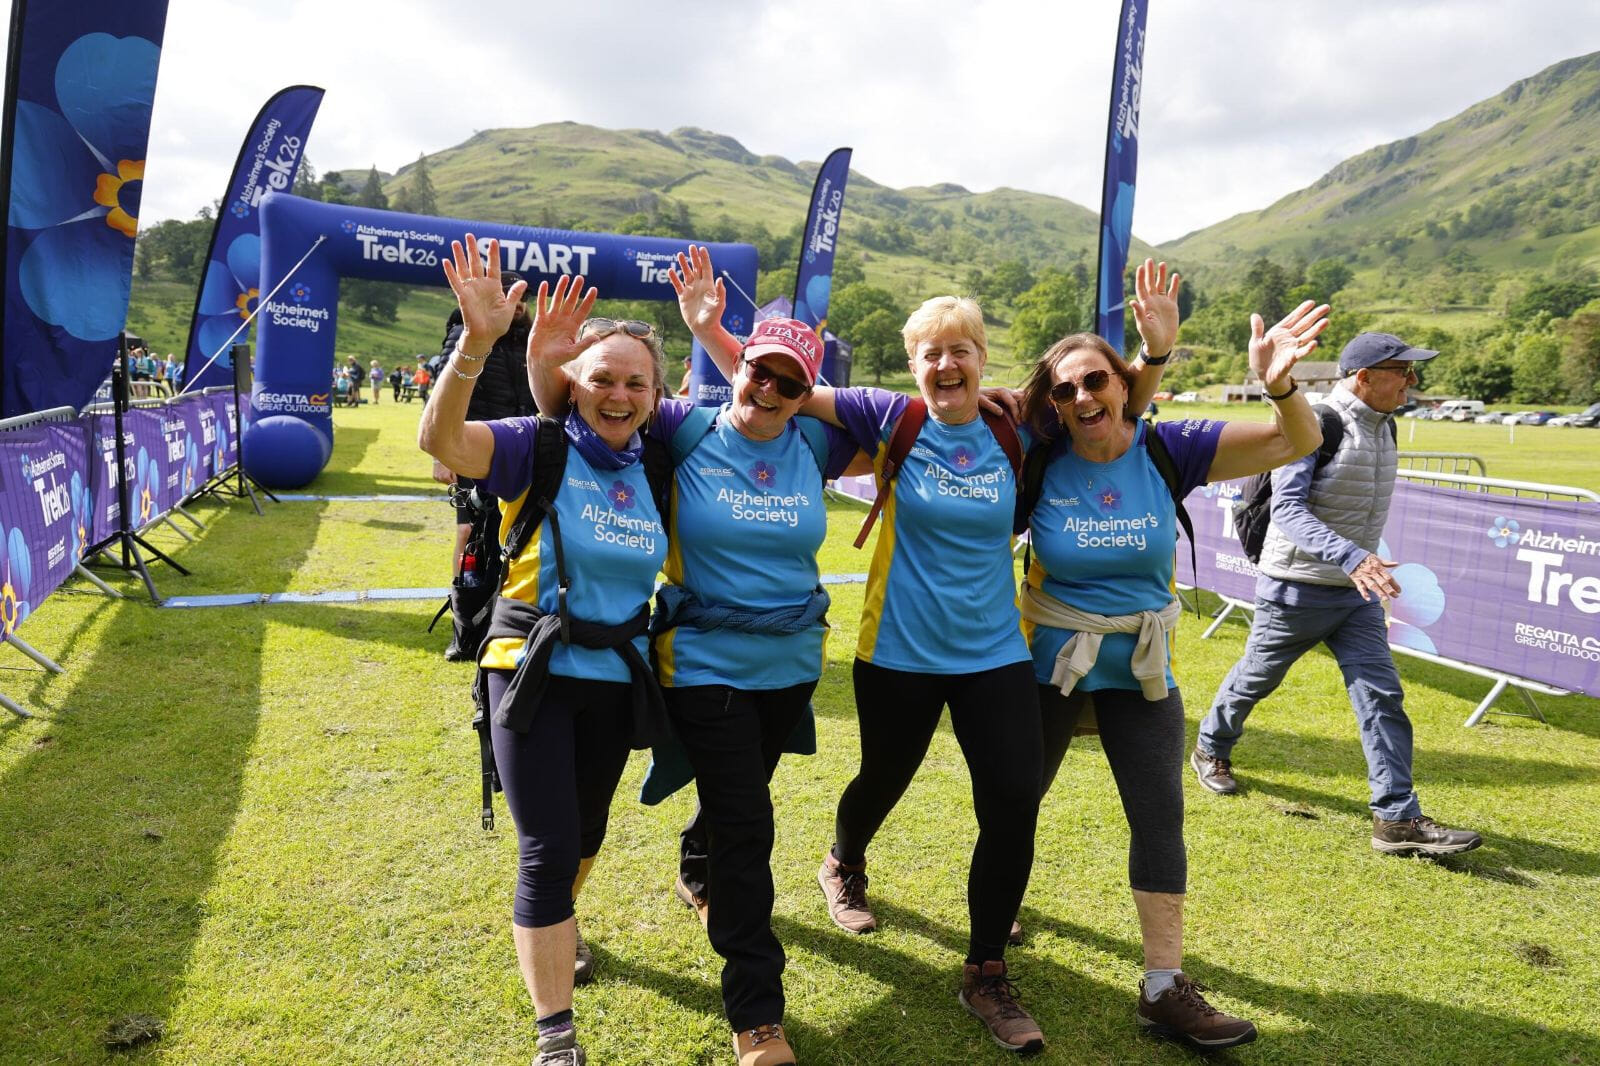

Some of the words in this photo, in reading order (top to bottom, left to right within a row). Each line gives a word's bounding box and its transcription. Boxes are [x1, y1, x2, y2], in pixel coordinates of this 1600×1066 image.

[240, 153, 265, 205] Alzheimer's
[257, 118, 281, 154] Society
[356, 224, 409, 240] Alzheimer's
[409, 230, 445, 246] Society
[355, 233, 438, 267] Trek26
[265, 301, 329, 320] Alzheimer's
[273, 313, 320, 332] Society
[763, 326, 817, 361] ITALIA
[259, 393, 309, 405] REGATTA
[698, 384, 733, 395] REGATT
[717, 487, 810, 507] Alzheimer's
[937, 479, 999, 503] Society
[731, 504, 799, 527] Society
[1063, 512, 1159, 532] Alzheimer's
[593, 524, 655, 555] Society
[1076, 532, 1147, 551] Society
[1516, 548, 1600, 614] Tre
[1515, 622, 1580, 648] REGATTA
[1514, 635, 1548, 649] GREAT
[1549, 642, 1600, 662] OUTDOO
